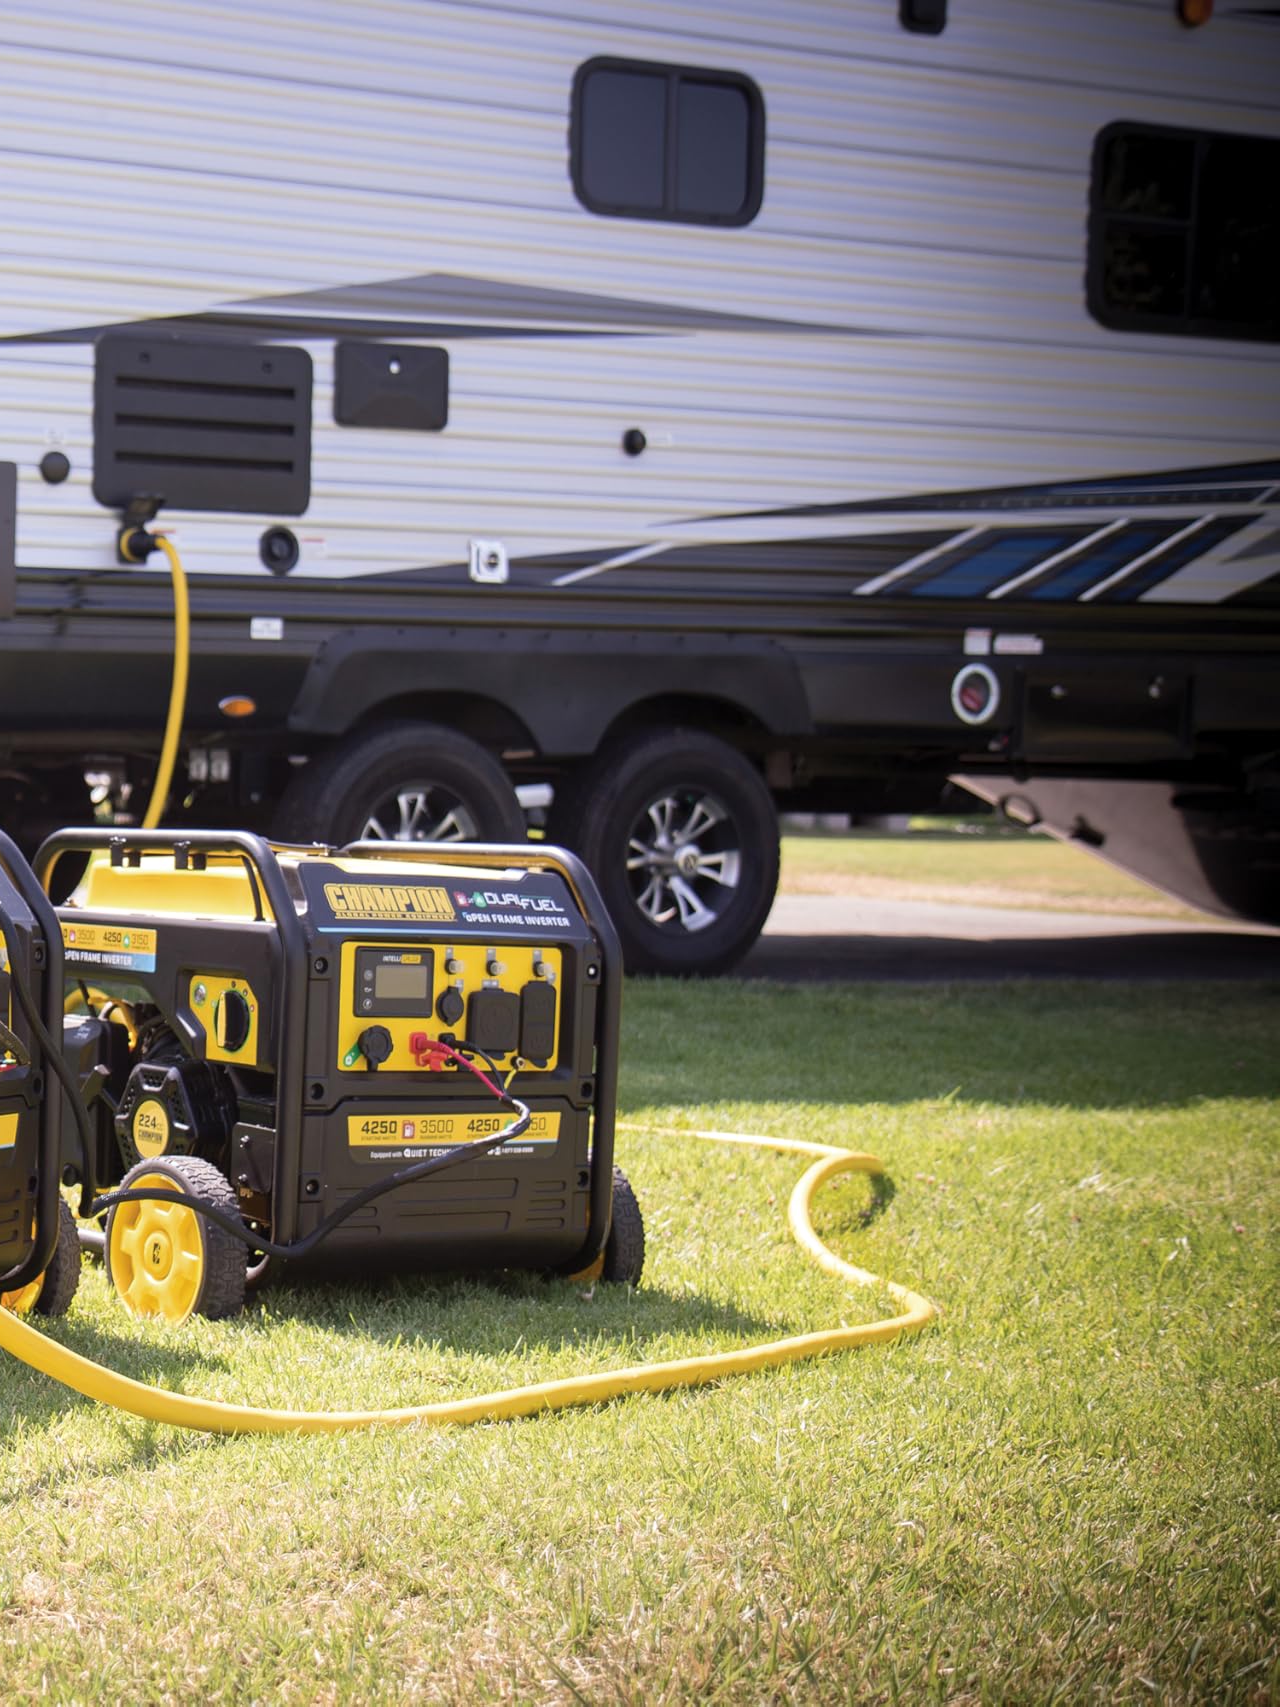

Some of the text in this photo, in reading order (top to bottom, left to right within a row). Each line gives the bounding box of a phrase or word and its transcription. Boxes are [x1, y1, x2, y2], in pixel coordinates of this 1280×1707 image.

[326, 885, 453, 913] CHAMPION
[520, 898, 565, 912] FUEL
[492, 914, 524, 925] FRAME
[524, 916, 571, 927] INVERTER
[103, 931, 122, 943] 4250
[361, 1120, 398, 1134] 4250
[419, 1119, 454, 1133] 3500
[467, 1118, 500, 1132] 4250
[403, 1148, 427, 1158] QUIET
